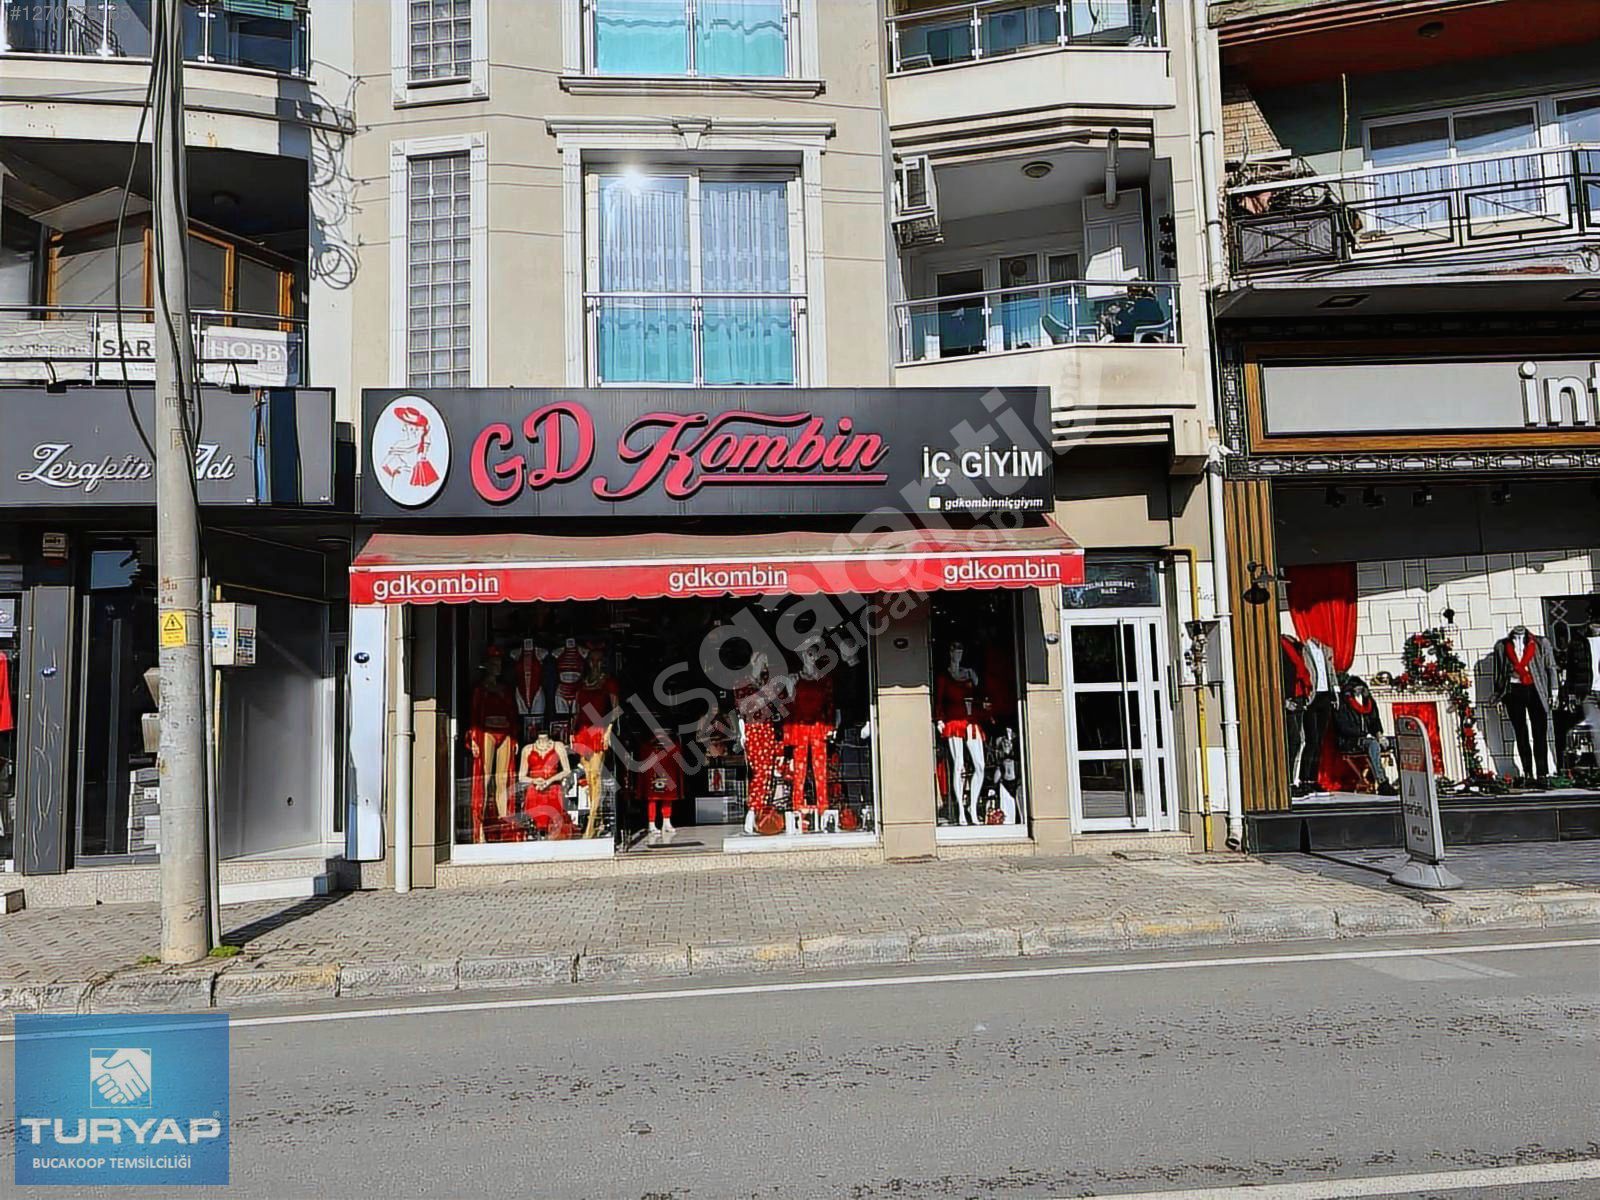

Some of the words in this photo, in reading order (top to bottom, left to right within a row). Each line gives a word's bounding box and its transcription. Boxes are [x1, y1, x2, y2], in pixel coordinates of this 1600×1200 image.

[470, 401, 595, 505] GD
[593, 411, 889, 500] Kombin
[922, 446, 951, 485] İÇ
[961, 445, 1043, 478] GİYİM
[373, 573, 498, 600] gdkombin
[669, 564, 788, 592] gdkombin
[944, 560, 1060, 584] gdkombin
